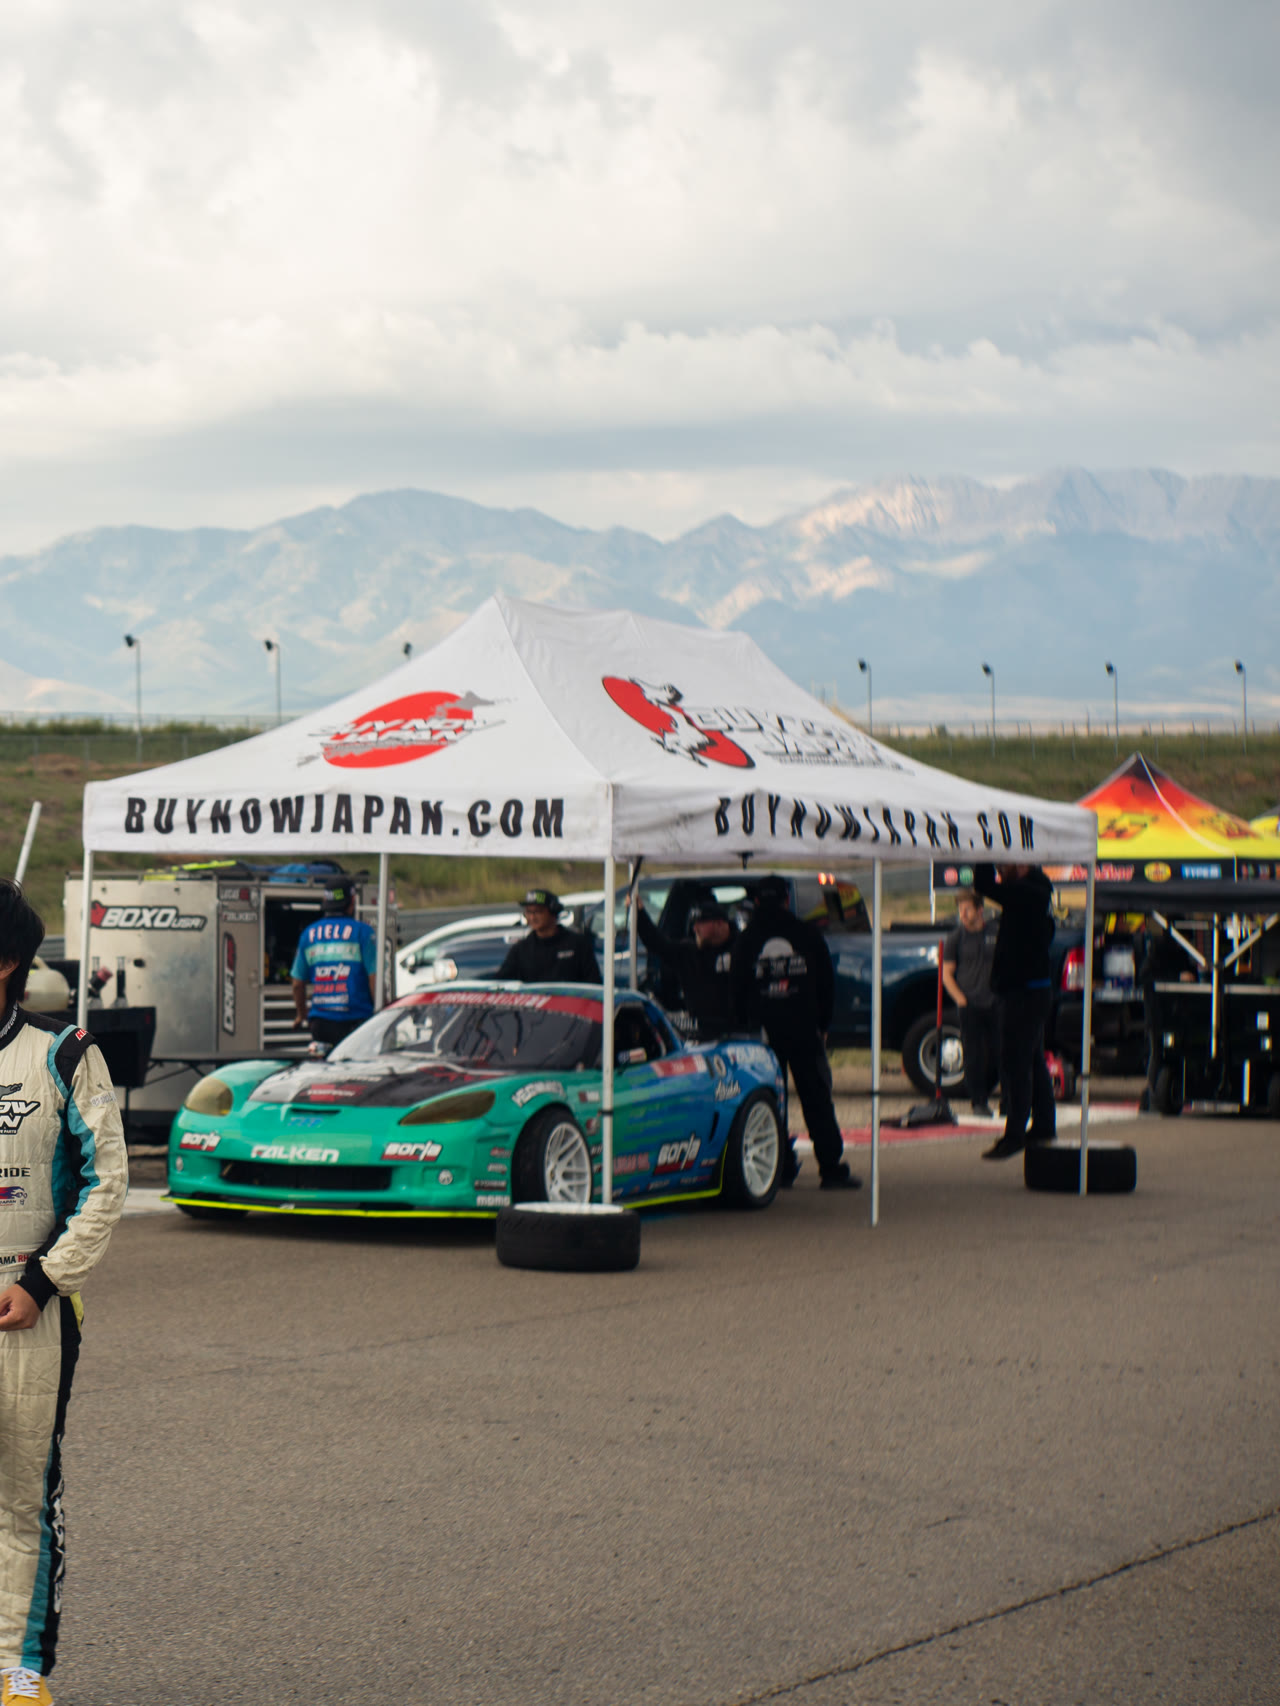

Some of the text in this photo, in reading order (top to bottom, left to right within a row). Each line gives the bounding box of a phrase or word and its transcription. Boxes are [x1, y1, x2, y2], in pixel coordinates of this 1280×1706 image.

[124, 794, 565, 838] BUYNOWJAPAN.COM
[309, 924, 353, 942] FIELD
[251, 1145, 340, 1163] FALKEN
